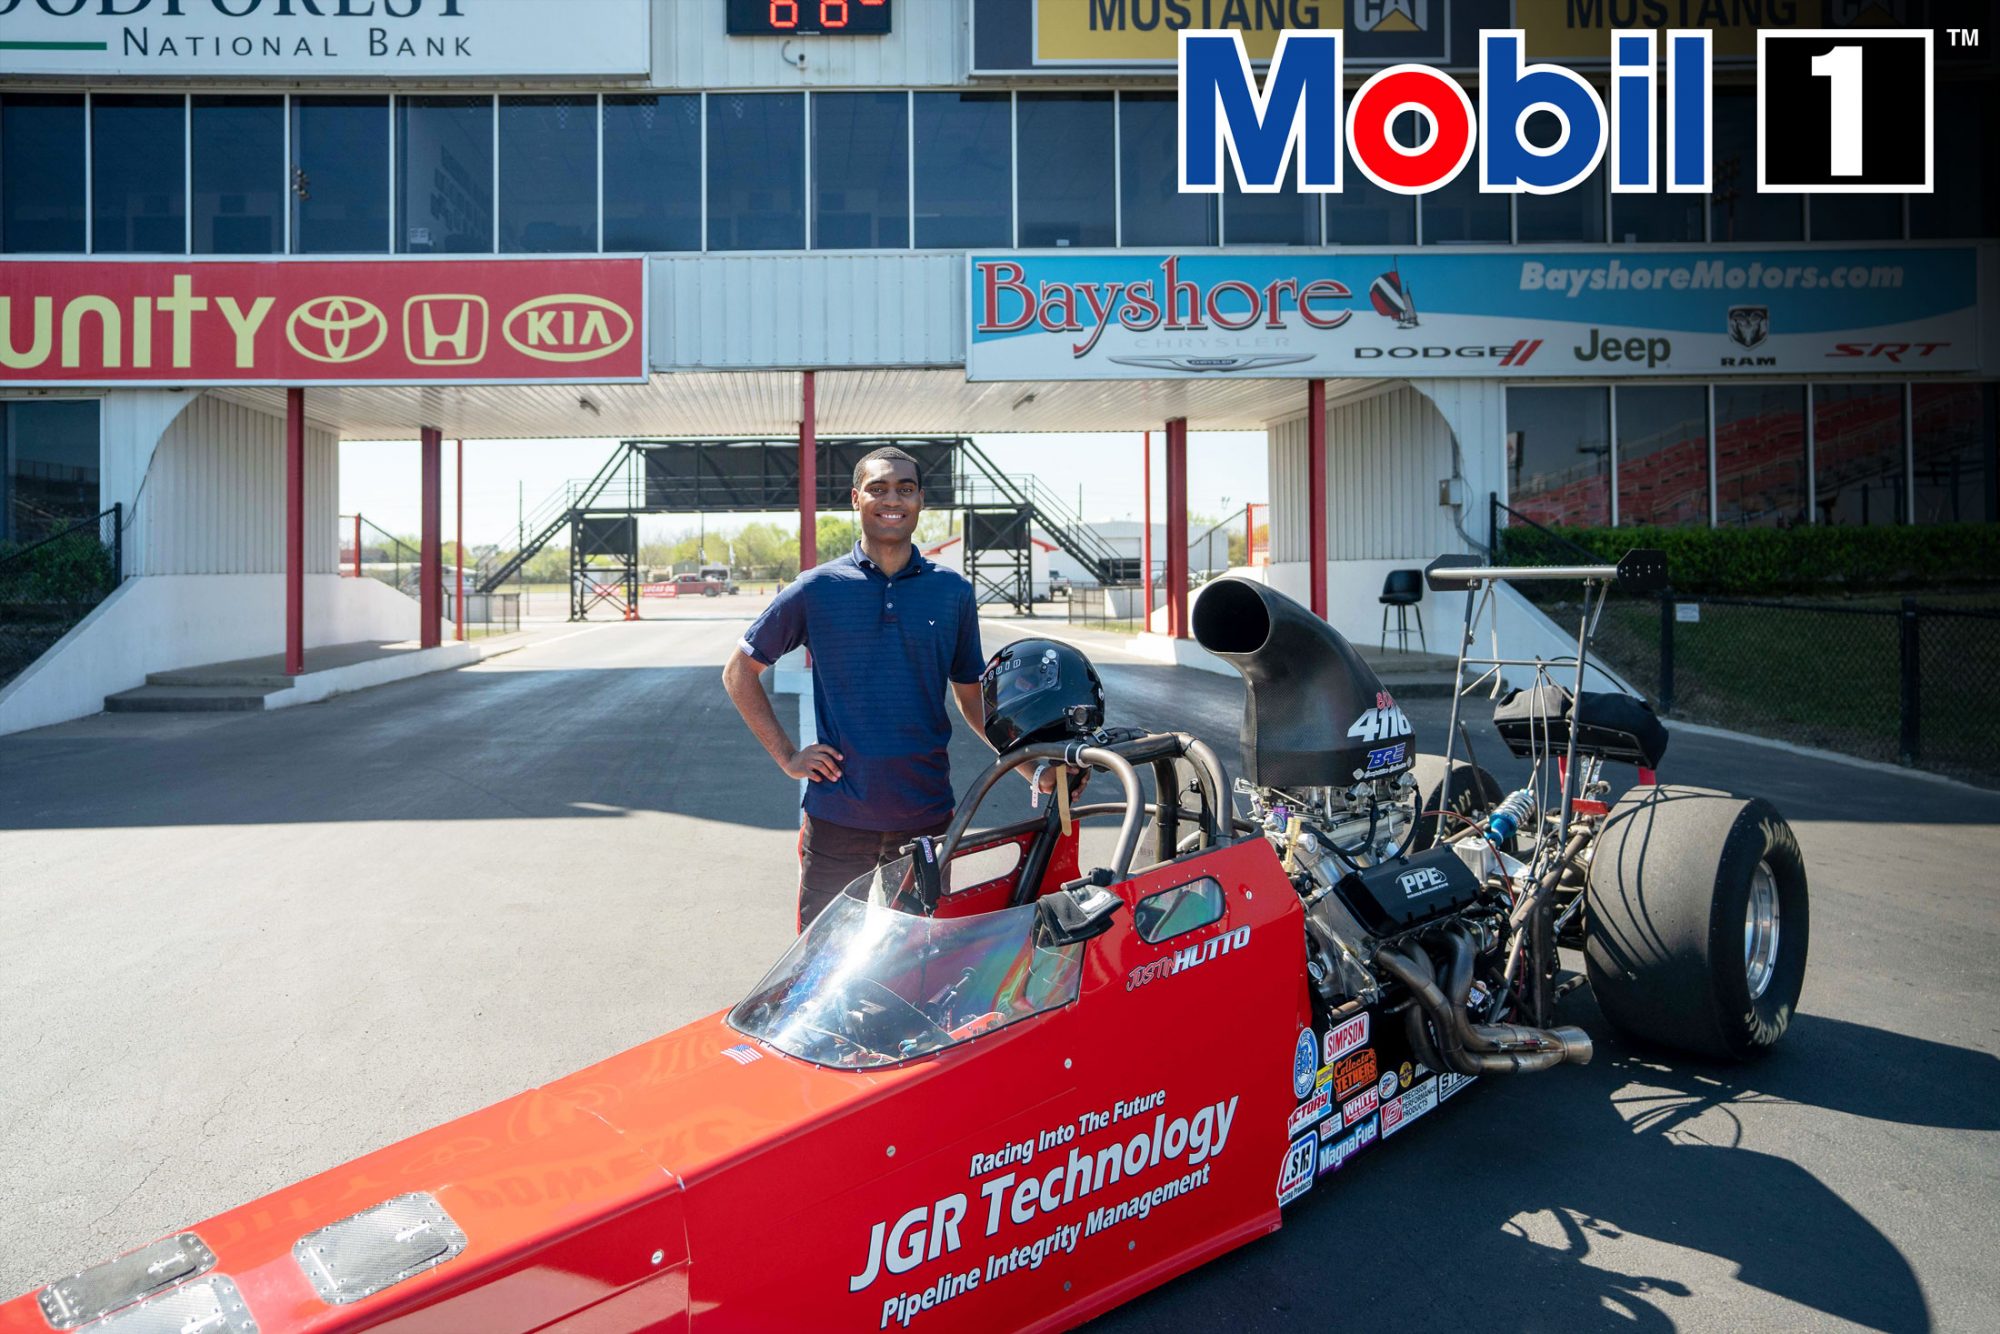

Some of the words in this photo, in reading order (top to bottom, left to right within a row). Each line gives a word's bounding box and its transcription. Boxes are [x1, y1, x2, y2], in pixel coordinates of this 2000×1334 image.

[1519, 259, 1905, 298] BayshoreMotors.com
[975, 255, 1354, 358] Bayshore
[526, 310, 613, 346] KIA
[1133, 336, 1291, 350] CHRYSLER
[1354, 345, 1516, 360] DODGE
[1572, 329, 1672, 368] Jeep
[1720, 356, 1777, 367] RAM
[1824, 342, 1952, 362] SRT
[1401, 866, 1442, 894] PPE
[1126, 950, 1178, 992] JUSTIN
[1170, 924, 1251, 976] HUTTO
[1327, 1022, 1366, 1058] SIMPSON
[1345, 1088, 1378, 1116] WHITE
[969, 1138, 1035, 1178] Racing
[1038, 1123, 1075, 1153] Into
[1078, 1107, 1110, 1136] The
[1112, 1088, 1167, 1125] Future
[1319, 1115, 1378, 1173] MagnaFuel
[848, 1192, 968, 1293] JGR
[980, 1094, 1240, 1237] Technology
[880, 1265, 982, 1330] Pipeline
[984, 1220, 1082, 1282] Integrity
[1083, 1161, 1212, 1239] Management
